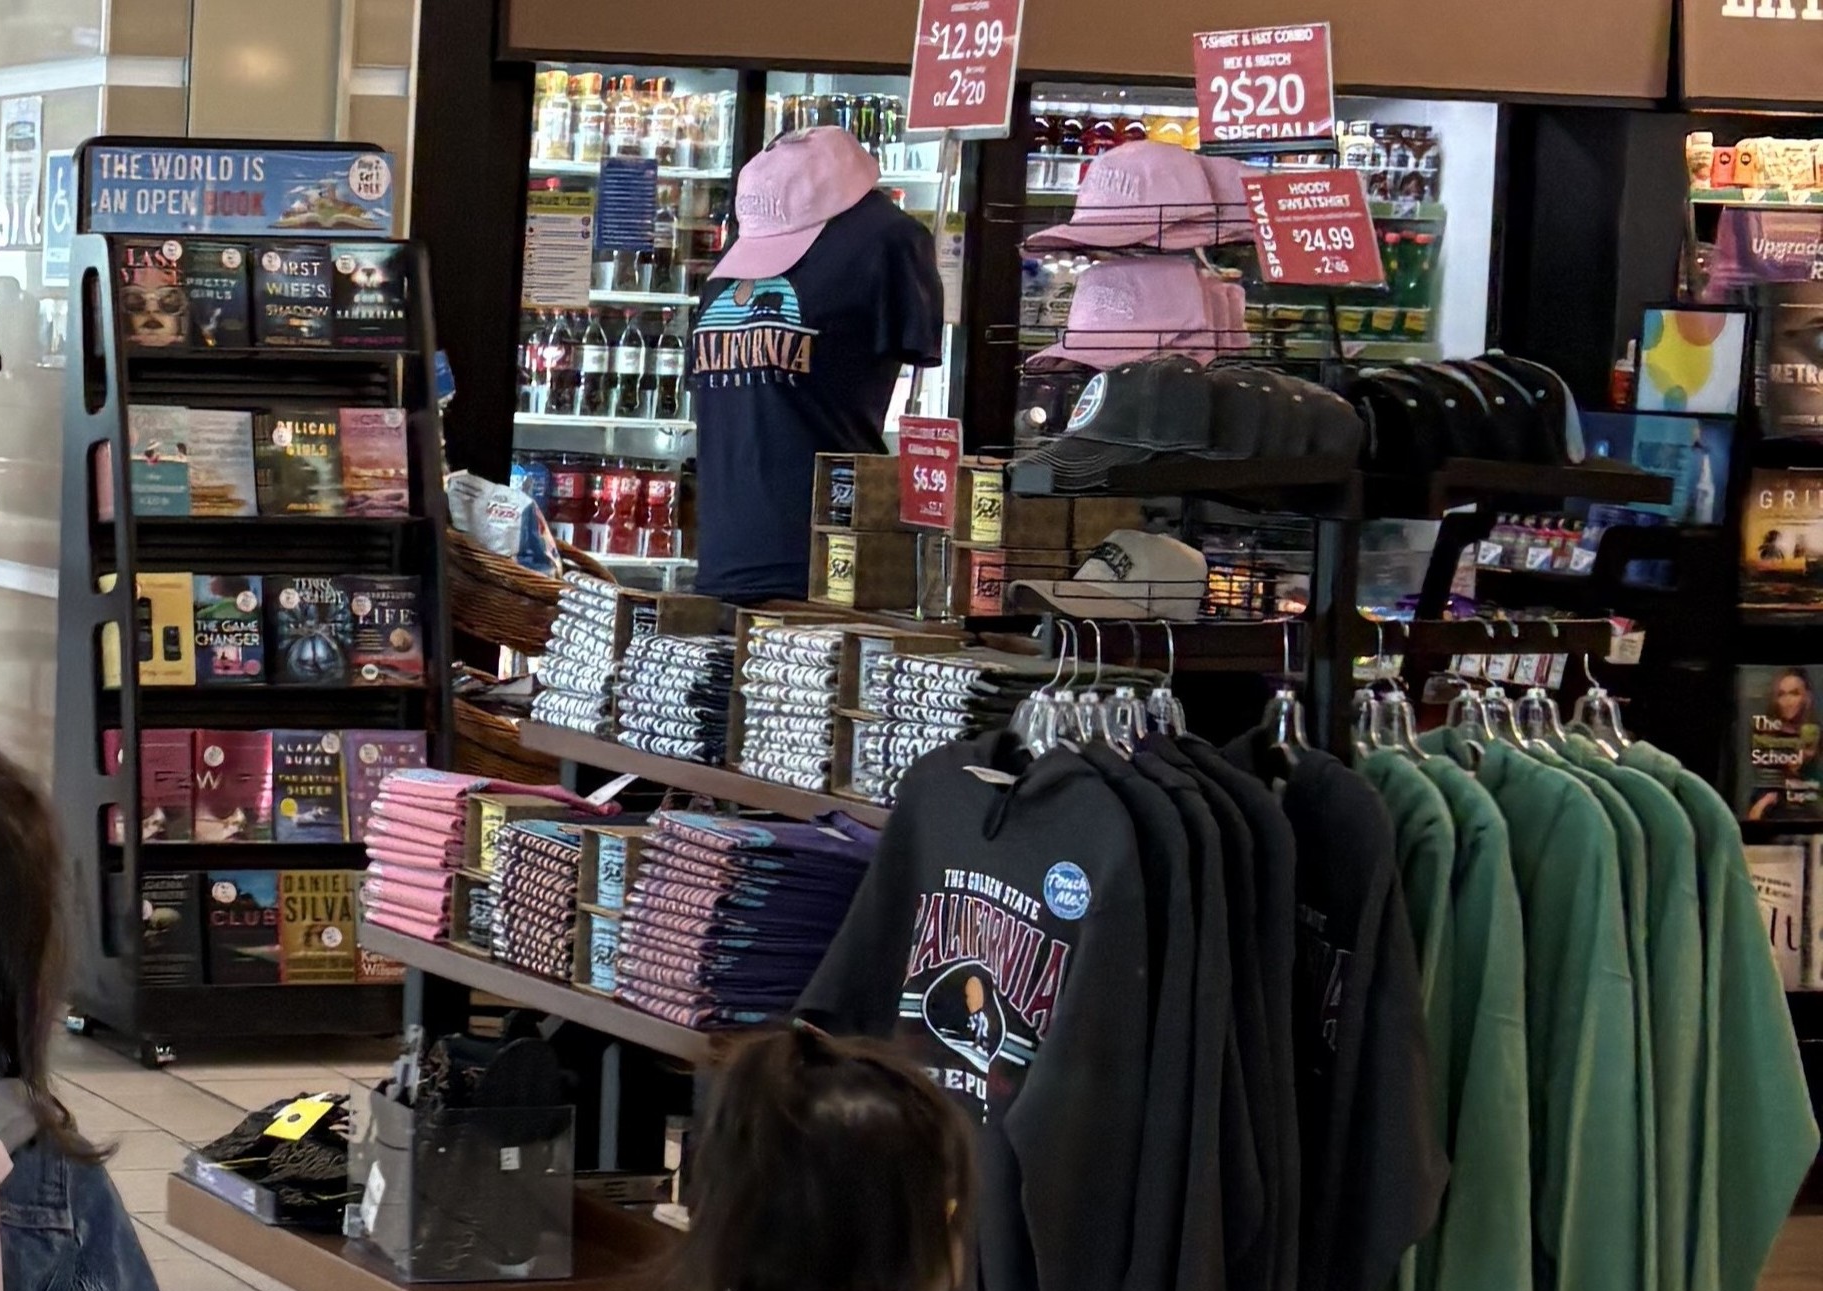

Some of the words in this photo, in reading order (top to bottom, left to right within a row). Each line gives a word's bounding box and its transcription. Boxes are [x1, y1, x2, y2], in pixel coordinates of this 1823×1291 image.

[930, 19, 1004, 60] $12.99
[1274, 27, 1314, 44] COMBO
[99, 153, 143, 181] THE
[151, 153, 234, 182] WORLD
[243, 156, 266, 182] IS
[1288, 181, 1331, 195] HOODY
[98, 187, 129, 214] AN
[135, 188, 198, 216] OPEN
[203, 189, 267, 217] BOOK
[1277, 194, 1351, 211] SWEATSHIRT
[1247, 183, 1284, 278] SPECIAL!
[1292, 226, 1355, 252] $24.99
[125, 247, 177, 268] LAS
[282, 261, 321, 276] IRST
[190, 288, 233, 301] GIRLS
[265, 281, 328, 299] WIFE'S
[265, 304, 330, 318] SHADOW
[692, 328, 812, 375] ALIFORNIA
[1769, 363, 1823, 385] RETR
[286, 443, 328, 457] GIRLS
[912, 463, 947, 493] $6.99
[1759, 488, 1823, 510] GRI
[196, 619, 219, 633] THE
[222, 619, 259, 633] GAME
[195, 632, 260, 647] CHANGER
[1752, 714, 1784, 731] The
[277, 743, 323, 753] ALAFA
[285, 755, 332, 766] BURKE
[1751, 749, 1805, 766] School
[287, 785, 333, 796] SISTER
[283, 875, 355, 893] DANIEL
[1048, 872, 1088, 891] Touch
[944, 868, 966, 889] THE
[968, 872, 1004, 904] GOLDEN
[1002, 885, 1042, 921] STATE
[210, 908, 278, 926] CLUB
[284, 895, 353, 922] SILVA
